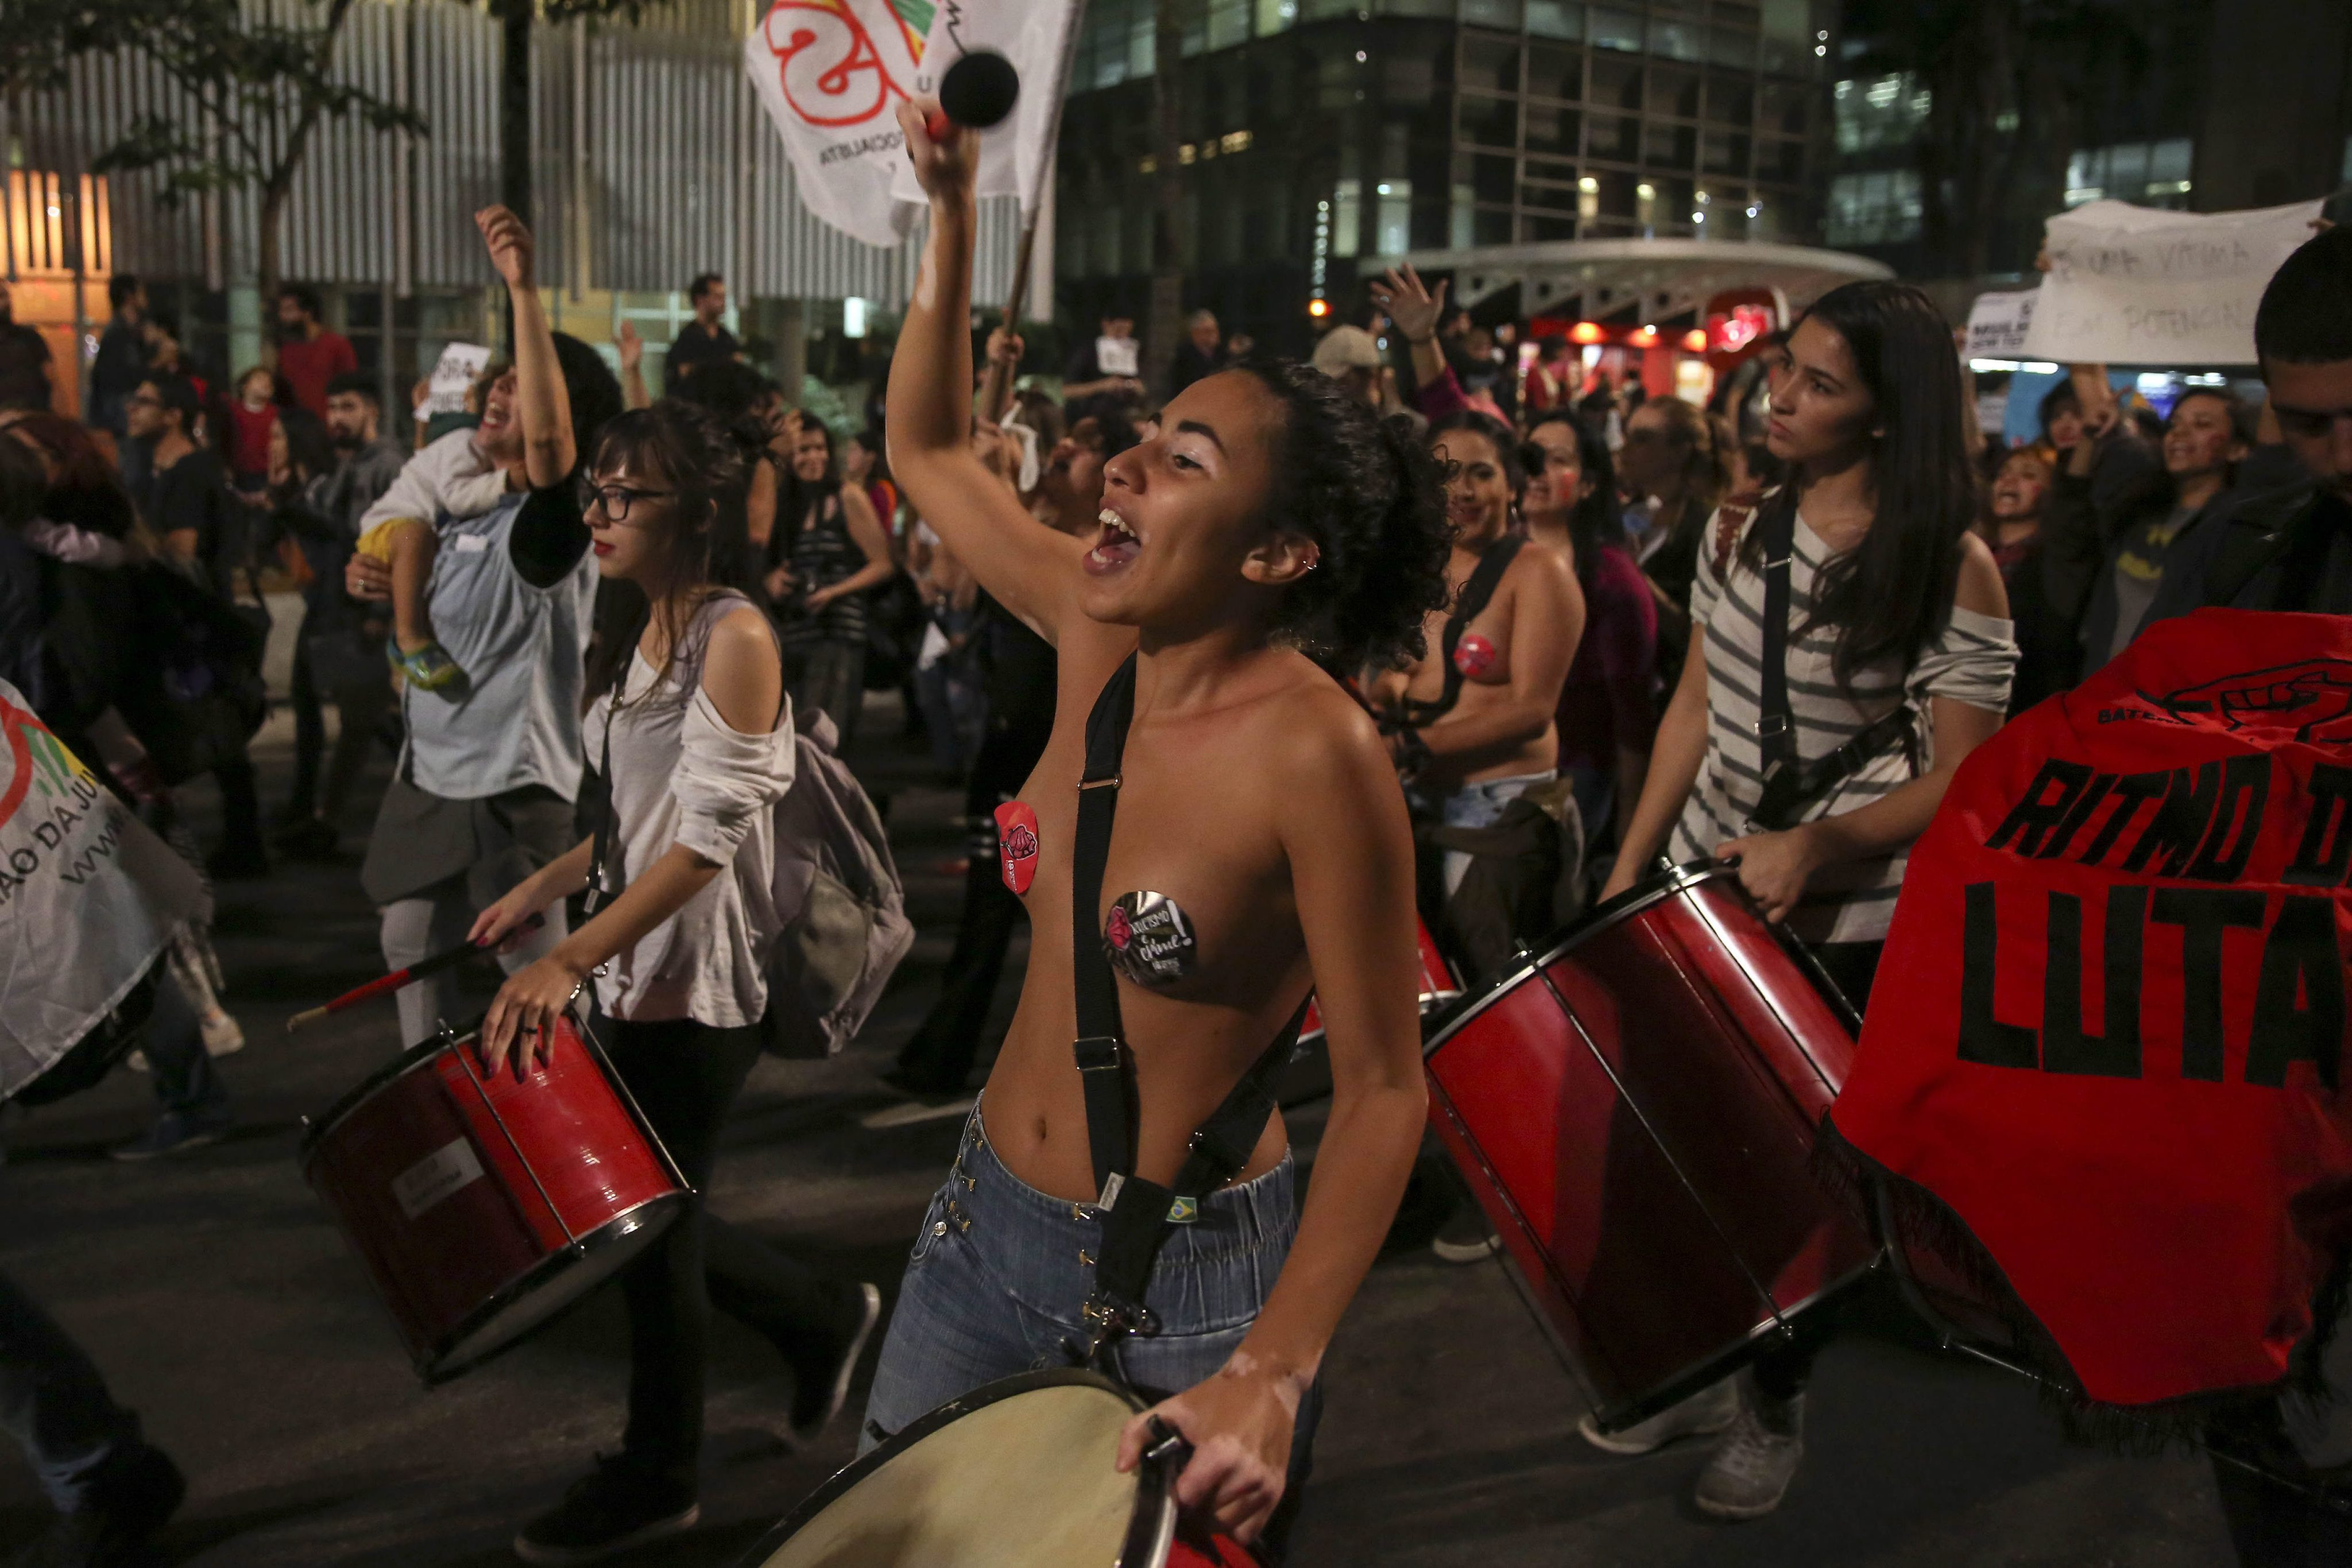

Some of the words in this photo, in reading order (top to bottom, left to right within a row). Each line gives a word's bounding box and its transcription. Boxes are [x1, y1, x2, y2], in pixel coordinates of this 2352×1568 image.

[71, 769, 100, 810] JU
[1984, 753, 2272, 883] RITMO
[2281, 760, 2352, 888] D
[1956, 880, 2346, 1094] LUTA
